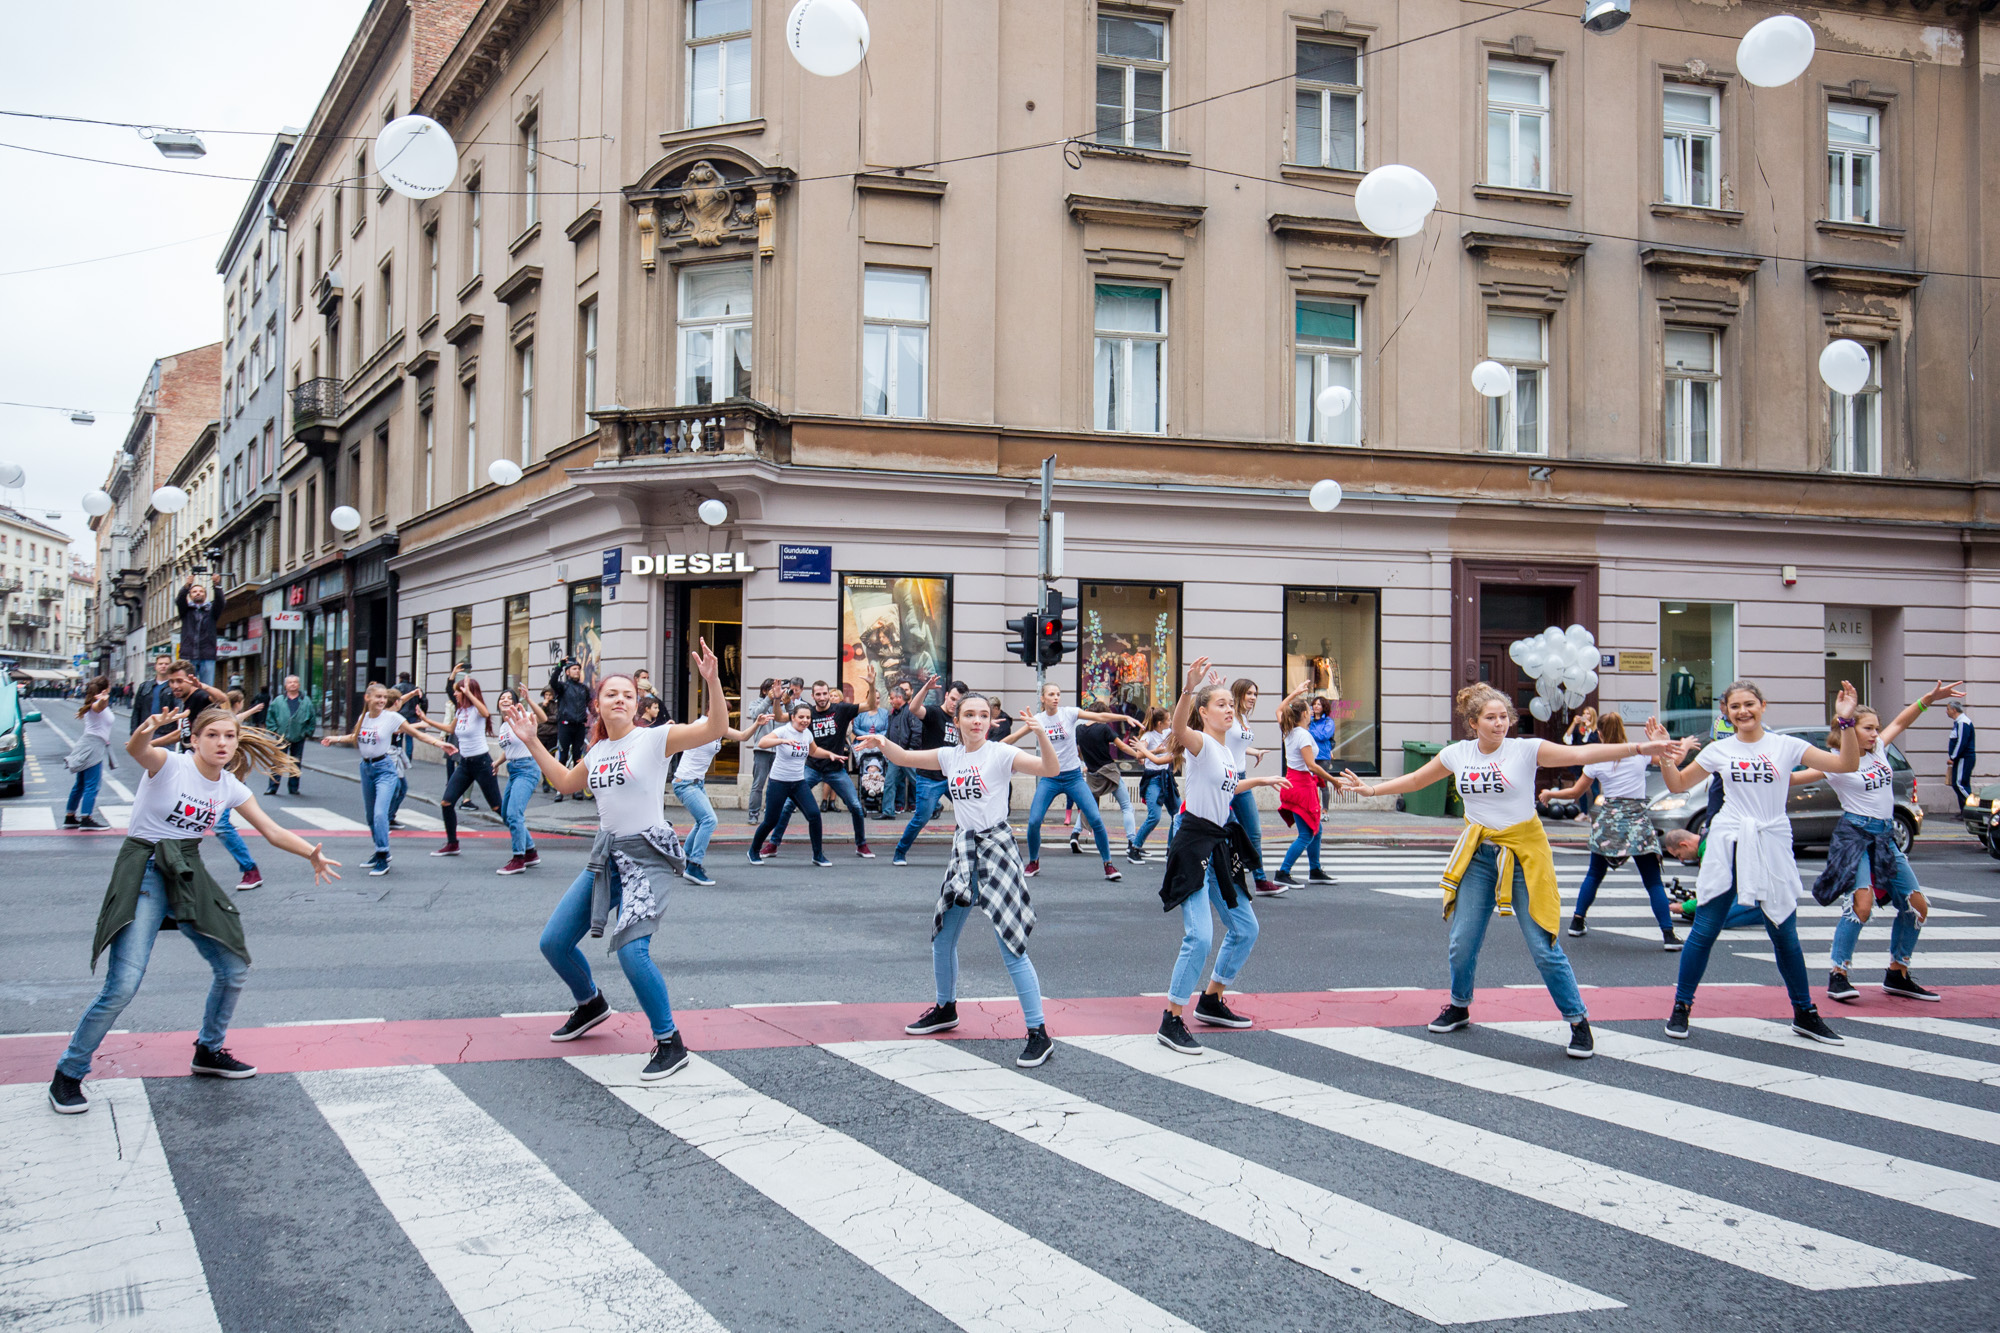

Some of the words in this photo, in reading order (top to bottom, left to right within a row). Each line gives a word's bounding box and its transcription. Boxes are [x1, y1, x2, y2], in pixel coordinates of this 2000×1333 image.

[631, 552, 755, 575] DIESEL
[847, 578, 887, 586] DIESEL
[814, 727, 837, 738] ELFS
[590, 773, 625, 789] ELFS
[1731, 772, 1774, 783] ELFS
[1865, 776, 1892, 791] ELFS
[951, 788, 983, 801] ELFS
[1460, 783, 1505, 794] ELFS
[165, 813, 207, 833] ELFS
